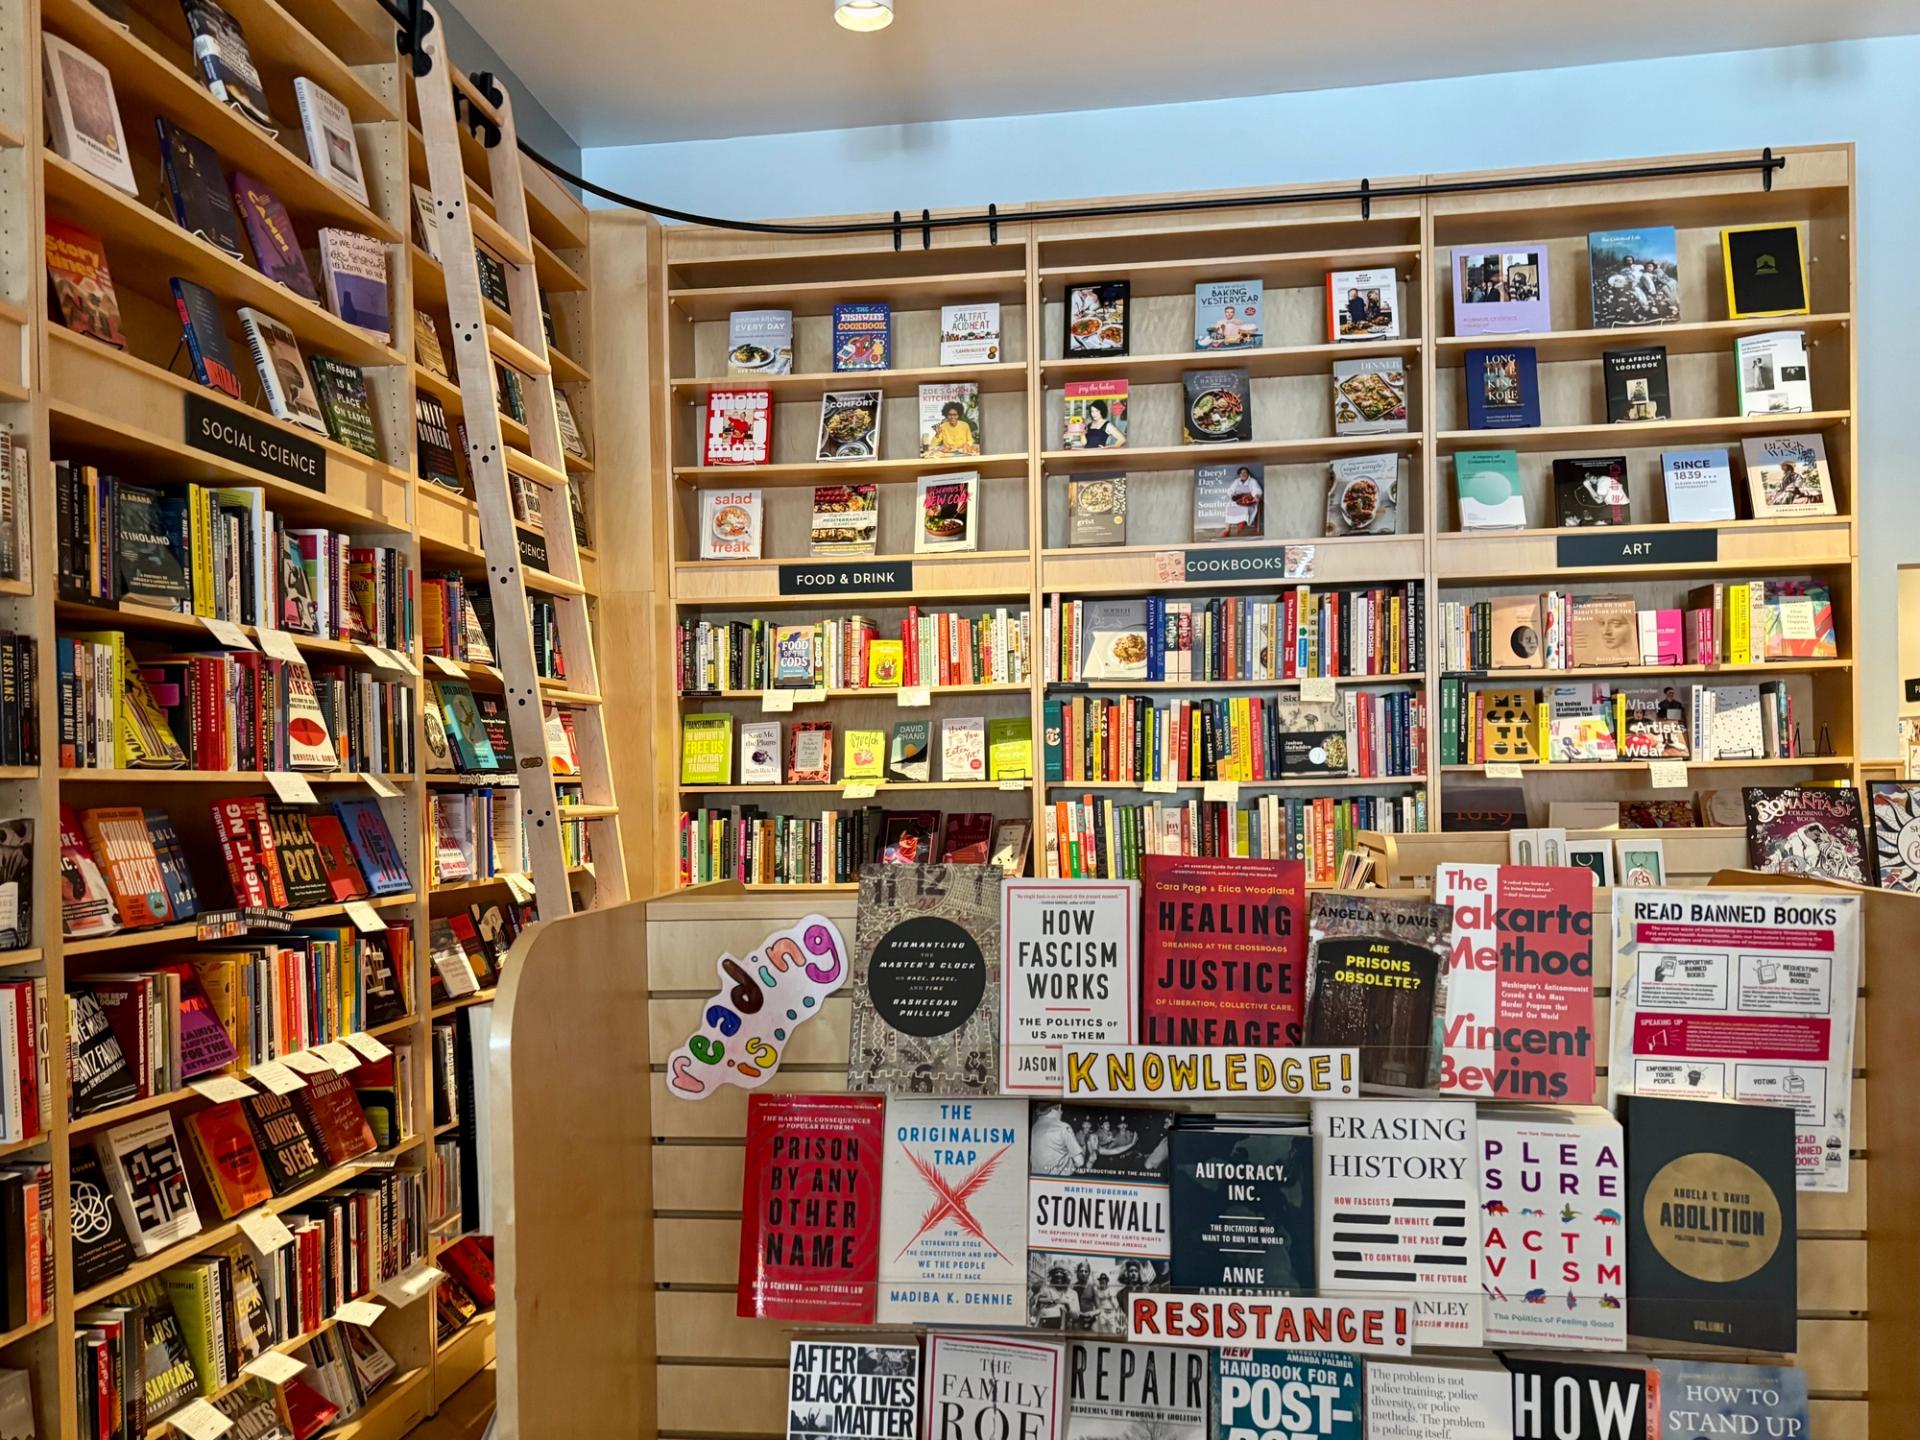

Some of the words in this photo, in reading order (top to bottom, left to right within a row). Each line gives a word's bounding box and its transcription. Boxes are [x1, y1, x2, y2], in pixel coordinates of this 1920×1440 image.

[1200, 295, 1259, 306] YESTERYEAR
[1211, 288, 1247, 297] BAKING
[952, 321, 970, 331] ACID
[970, 320, 990, 330] HEAT
[954, 312, 971, 322] SALT
[971, 311, 987, 321] FAT
[735, 323, 764, 331] EVERY
[767, 322, 785, 330] DAY
[838, 322, 886, 331] COOKBOOK
[1361, 361, 1400, 370] DINNER
[1485, 354, 1516, 363] LONG
[1615, 362, 1658, 371] LOOKBOOK
[1628, 354, 1661, 363] AFRICAN
[325, 361, 356, 379] HEAVEN
[1487, 366, 1517, 376] LIVE
[1488, 378, 1517, 388] KING
[337, 393, 360, 408] PLACE
[830, 399, 874, 408] COMFORT
[1488, 390, 1519, 400] KOBE
[334, 405, 345, 417] ON
[348, 410, 371, 425] EARTH
[416, 399, 447, 428] WHITE
[202, 417, 255, 453] SOCIAL
[261, 441, 316, 475] SCIENCE
[1673, 459, 1711, 470] SINCE
[1198, 478, 1223, 488] Day's
[1199, 469, 1227, 479] Cheryl
[715, 493, 752, 505] salad
[121, 529, 170, 546] TINOLAND
[520, 541, 545, 561] CIENCE
[713, 541, 750, 553] freak
[1622, 542, 1652, 555] ART
[1186, 557, 1282, 573] COOKBOOKS
[797, 574, 835, 586] FOOD
[840, 573, 849, 584] &
[854, 571, 895, 583] DRINK
[782, 641, 808, 650] FOOD
[3, 645, 15, 703] PERSIANS
[1626, 699, 1660, 711] What
[899, 732, 925, 740] CHANG
[1635, 722, 1685, 734] Artists
[1626, 745, 1664, 758] Wear
[271, 814, 314, 846] JACK
[282, 849, 319, 882] POT
[1155, 881, 1180, 893] Cara
[1182, 882, 1207, 895] Page
[1217, 883, 1242, 894] Erica
[1244, 885, 1295, 896] Woodland
[1445, 870, 1487, 891] The
[174, 888, 197, 904] JOBS
[1042, 909, 1095, 935] HOW
[1158, 900, 1292, 937] HEALING
[1318, 906, 1375, 921] ANGELA
[1380, 911, 1392, 924] Y.
[1397, 913, 1439, 929] DAVIS
[1635, 902, 1682, 921] READ
[1691, 904, 1766, 925] BANNED
[1774, 906, 1837, 925] BOOKS
[891, 940, 966, 949] DISMANTLING
[1369, 944, 1390, 954] ARE
[1018, 941, 1118, 968] FASCISM
[1346, 954, 1411, 972] PRISONS
[1450, 936, 1593, 977] Method
[879, 961, 935, 969] MASTER'S
[940, 961, 976, 969] CLOCK
[1158, 958, 1292, 994] JUSTICE
[1334, 971, 1422, 991] OBSOLETE?
[1026, 973, 1109, 1000] WORKS
[25, 987, 34, 1048] EMPIRELAND
[672, 924, 841, 1093] reading
[899, 1009, 950, 1018] PHILLIPS
[1019, 1017, 1041, 1026] THE
[1046, 1018, 1103, 1027] POLITICS
[1031, 1031, 1047, 1040] US
[1072, 1031, 1106, 1040] THEM
[1149, 1016, 1302, 1047] LINEAGES
[1444, 1013, 1591, 1056] Vincent
[1018, 1056, 1057, 1072] JASON
[1067, 1051, 1352, 1094] KNOWLEDGE!
[1440, 1055, 1568, 1098] Bevins
[941, 1105, 972, 1120] THE
[264, 1113, 304, 1146] UNDER
[898, 1127, 1015, 1143] ORIGINALISM
[1328, 1116, 1467, 1141] ERASING
[773, 1136, 860, 1161] PRISON
[934, 1150, 976, 1165] TRAP
[278, 1139, 319, 1177] SIEGE
[1196, 1162, 1288, 1183] AUTOCRACY,
[1328, 1155, 1468, 1180] HISTORY
[771, 1167, 800, 1191] BY
[812, 1168, 858, 1193] ANY
[1064, 1186, 1093, 1194] MARTIN
[1096, 1187, 1138, 1197] DUBERMAN
[1228, 1185, 1260, 1201] INC.
[1674, 1188, 1708, 1199] ANGELA
[1724, 1192, 1750, 1204] DAVIS
[769, 1199, 856, 1228] OTHER
[1037, 1194, 1165, 1234] STONEWALL
[1660, 1202, 1765, 1236] ABOLITION
[766, 1233, 855, 1268] NAME
[1222, 1267, 1264, 1284] ANNE
[891, 1291, 939, 1303] MADIBA
[947, 1292, 959, 1304] K.
[965, 1292, 1013, 1305] DENNIE
[152, 1316, 178, 1345] JUST
[213, 1270, 221, 1298] ANITA
[217, 1334, 226, 1382] BELIEVING
[1133, 1299, 1407, 1346] RESISTANCE!
[794, 1344, 856, 1374] AFTER
[1222, 1347, 1251, 1358] NEW
[980, 1358, 1012, 1375] THE
[1220, 1361, 1300, 1381] HANDBOOK
[1308, 1370, 1337, 1384] FOR
[1343, 1373, 1354, 1387] A
[1070, 1346, 1202, 1408] REPAIR
[792, 1374, 856, 1405] BLACK
[861, 1376, 915, 1406] LIVES
[942, 1374, 1048, 1408] FAMILY
[1686, 1386, 1742, 1404] HOW
[1746, 1388, 1779, 1406] TO
[1221, 1376, 1352, 1433] POST-
[1514, 1372, 1640, 1440] HOW
[833, 1405, 914, 1438] MATTER
[1669, 1409, 1758, 1435] STAND
[1765, 1416, 1801, 1437] UP
